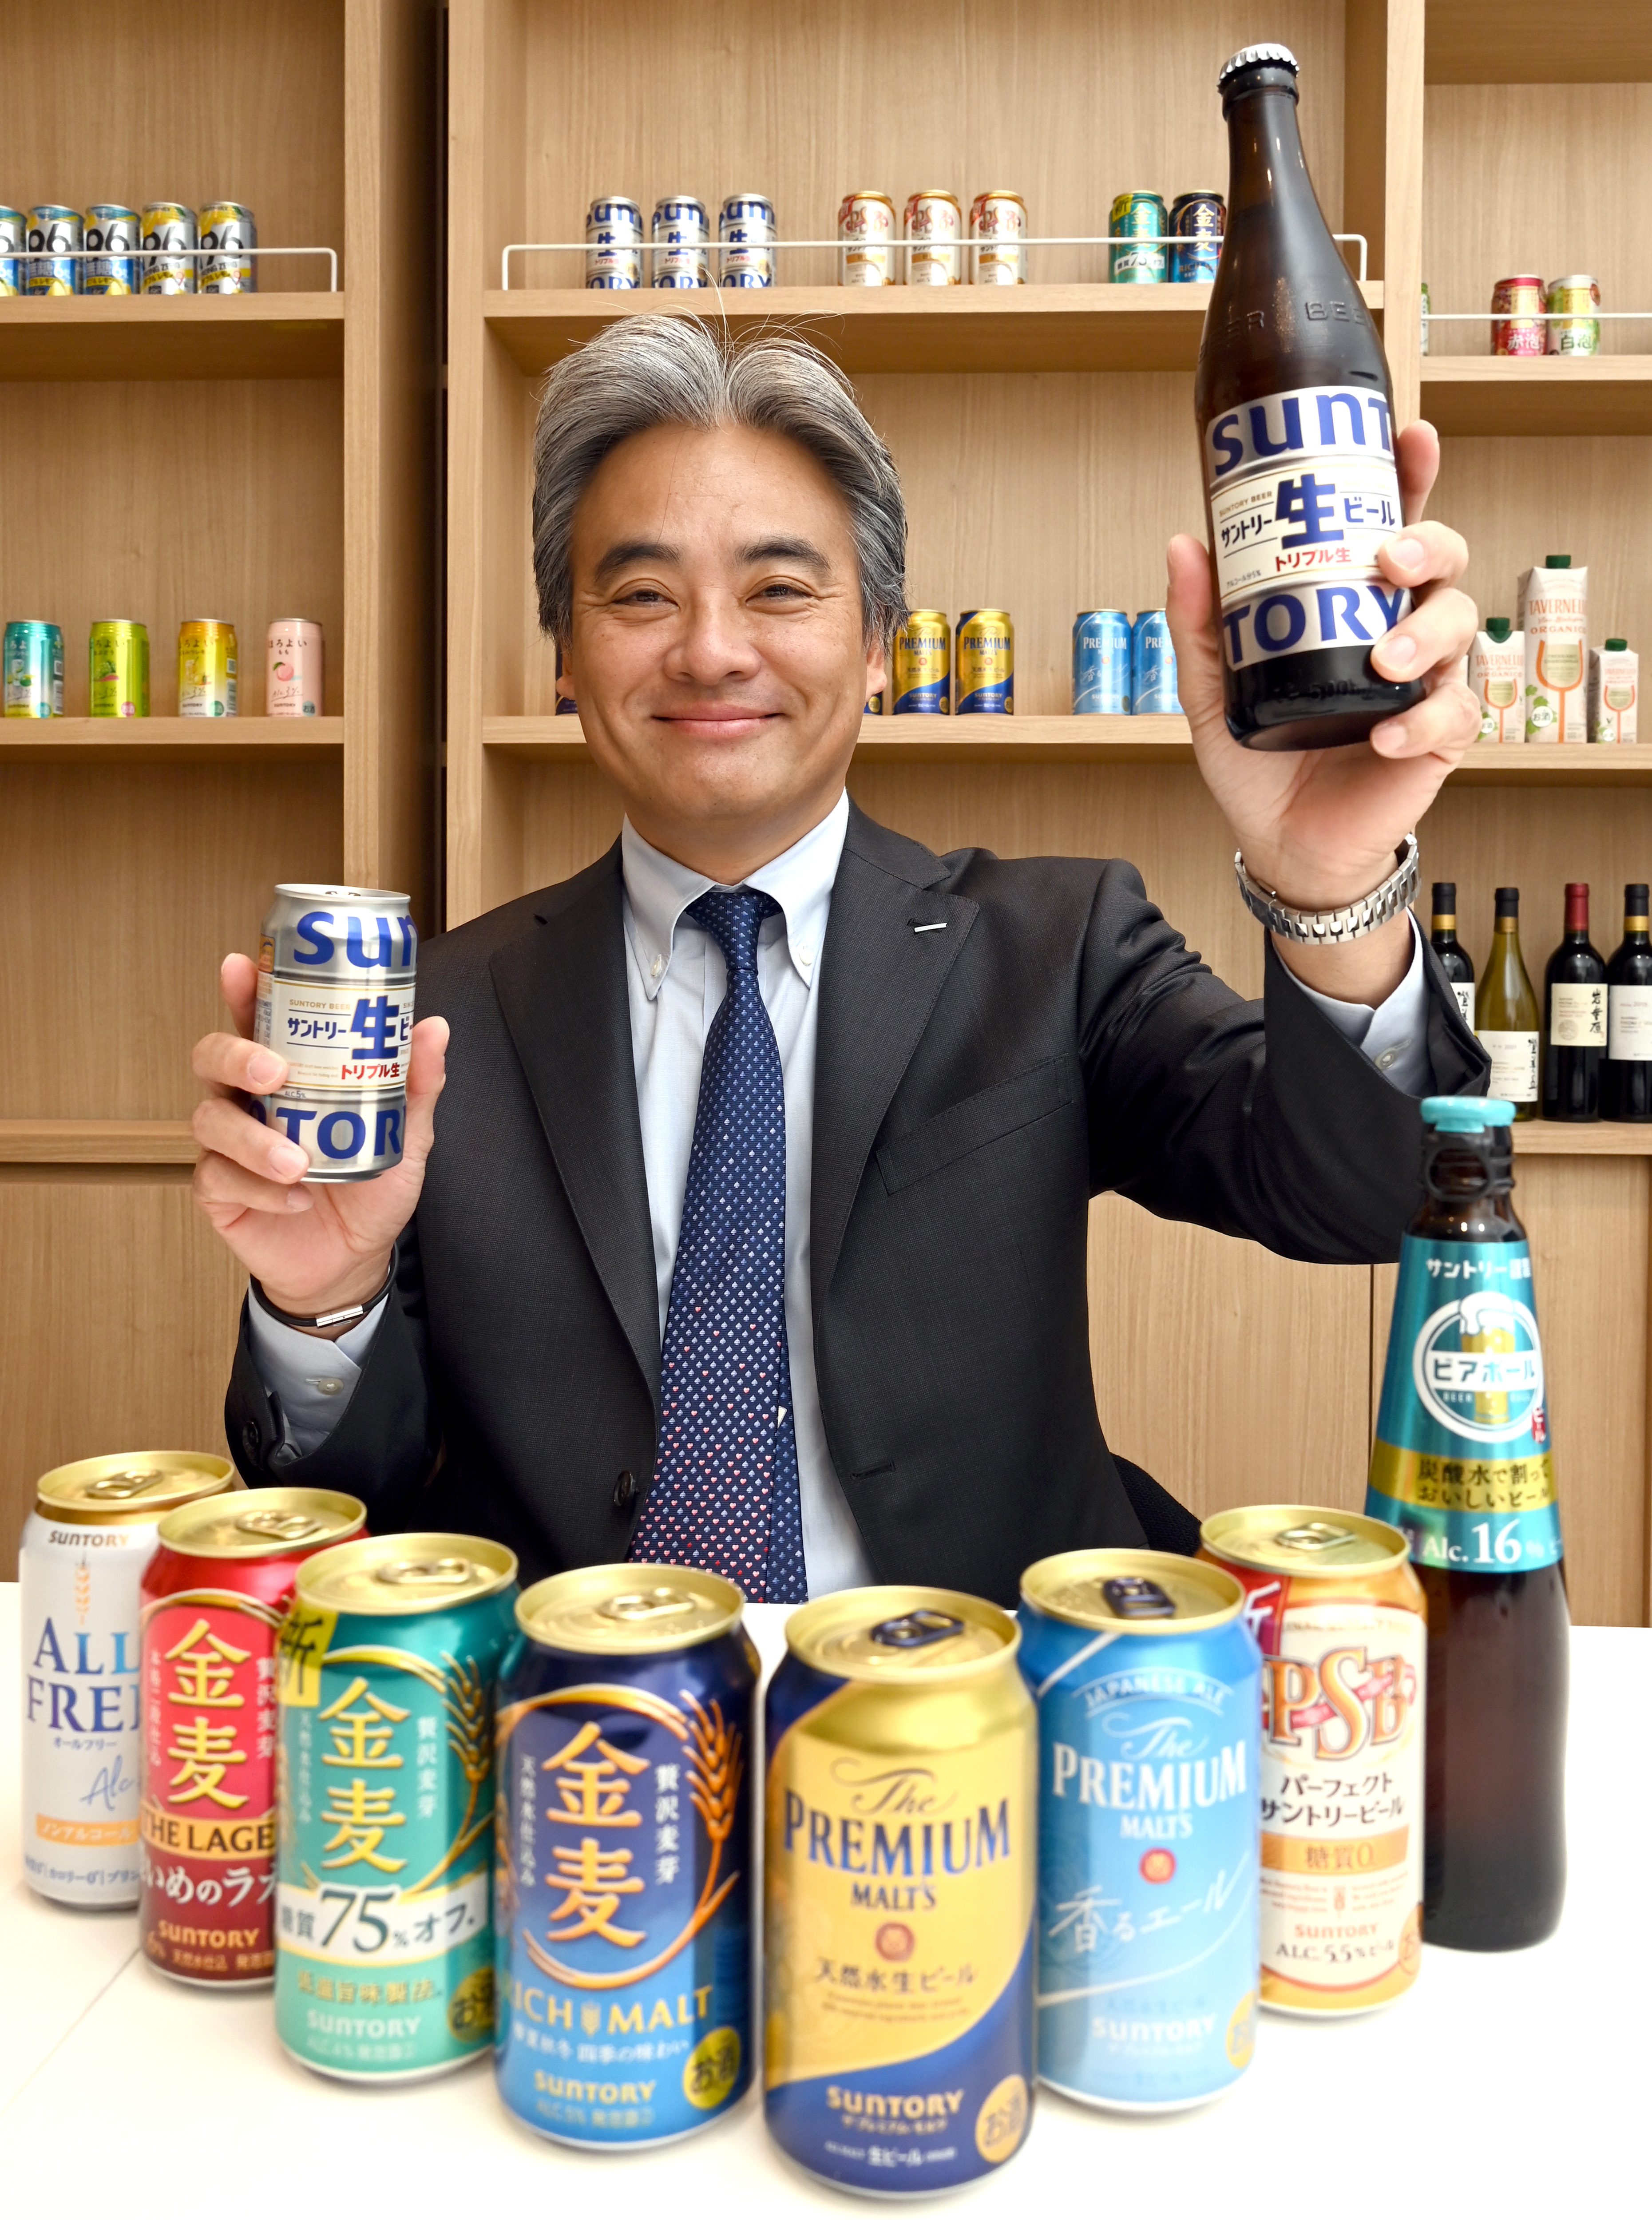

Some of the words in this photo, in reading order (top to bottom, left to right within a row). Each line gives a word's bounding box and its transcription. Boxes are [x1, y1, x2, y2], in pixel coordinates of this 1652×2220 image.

[1220, 498, 1249, 517] SUNTORY
[1251, 491, 1272, 503] BEER
[1275, 547, 1351, 572] トリプル生
[1223, 586, 1404, 665] TORY
[899, 637, 946, 650] PREMIUM
[964, 637, 1011, 650] PREMIUM
[1083, 637, 1127, 650] PREMIUM
[289, 999, 326, 1009] SUNTORY
[341, 1062, 400, 1080] トリプル生
[1443, 1391, 1473, 1403] BEER
[48, 1530, 130, 1547] SUNTORY
[1422, 1538, 1469, 1562] Alc.
[33, 1616, 139, 1675] ALL
[164, 1619, 252, 1809] 金麦
[1101, 1711, 1211, 1760] The
[319, 1677, 411, 1873] 金麦
[829, 1756, 959, 1816] The
[1052, 1739, 1247, 1812] PREMIUM
[1280, 1772, 1393, 1799] パーフェクト
[1120, 1809, 1194, 1840] MALT'S
[1261, 1796, 1406, 1828] サントリービール
[542, 1722, 650, 1947] 金麦
[784, 1786, 1010, 1878] PREMIUM
[1307, 1841, 1375, 1870] 糖質0
[851, 1879, 937, 1911] MALT'S
[1048, 1851, 1251, 1954] 香るエール
[158, 1919, 260, 1949] SUNTORY
[1294, 1923, 1379, 1939] SUNTORY
[816, 1955, 977, 1994] 天然水生ビール
[514, 1981, 573, 2030] ICH
[607, 1984, 713, 2035] MALT
[306, 2010, 421, 2038] SUNTORY
[1092, 2013, 1217, 2043] SUNTORY
[535, 2069, 656, 2105] SUNTORY
[826, 2085, 964, 2119] SUNTORY
